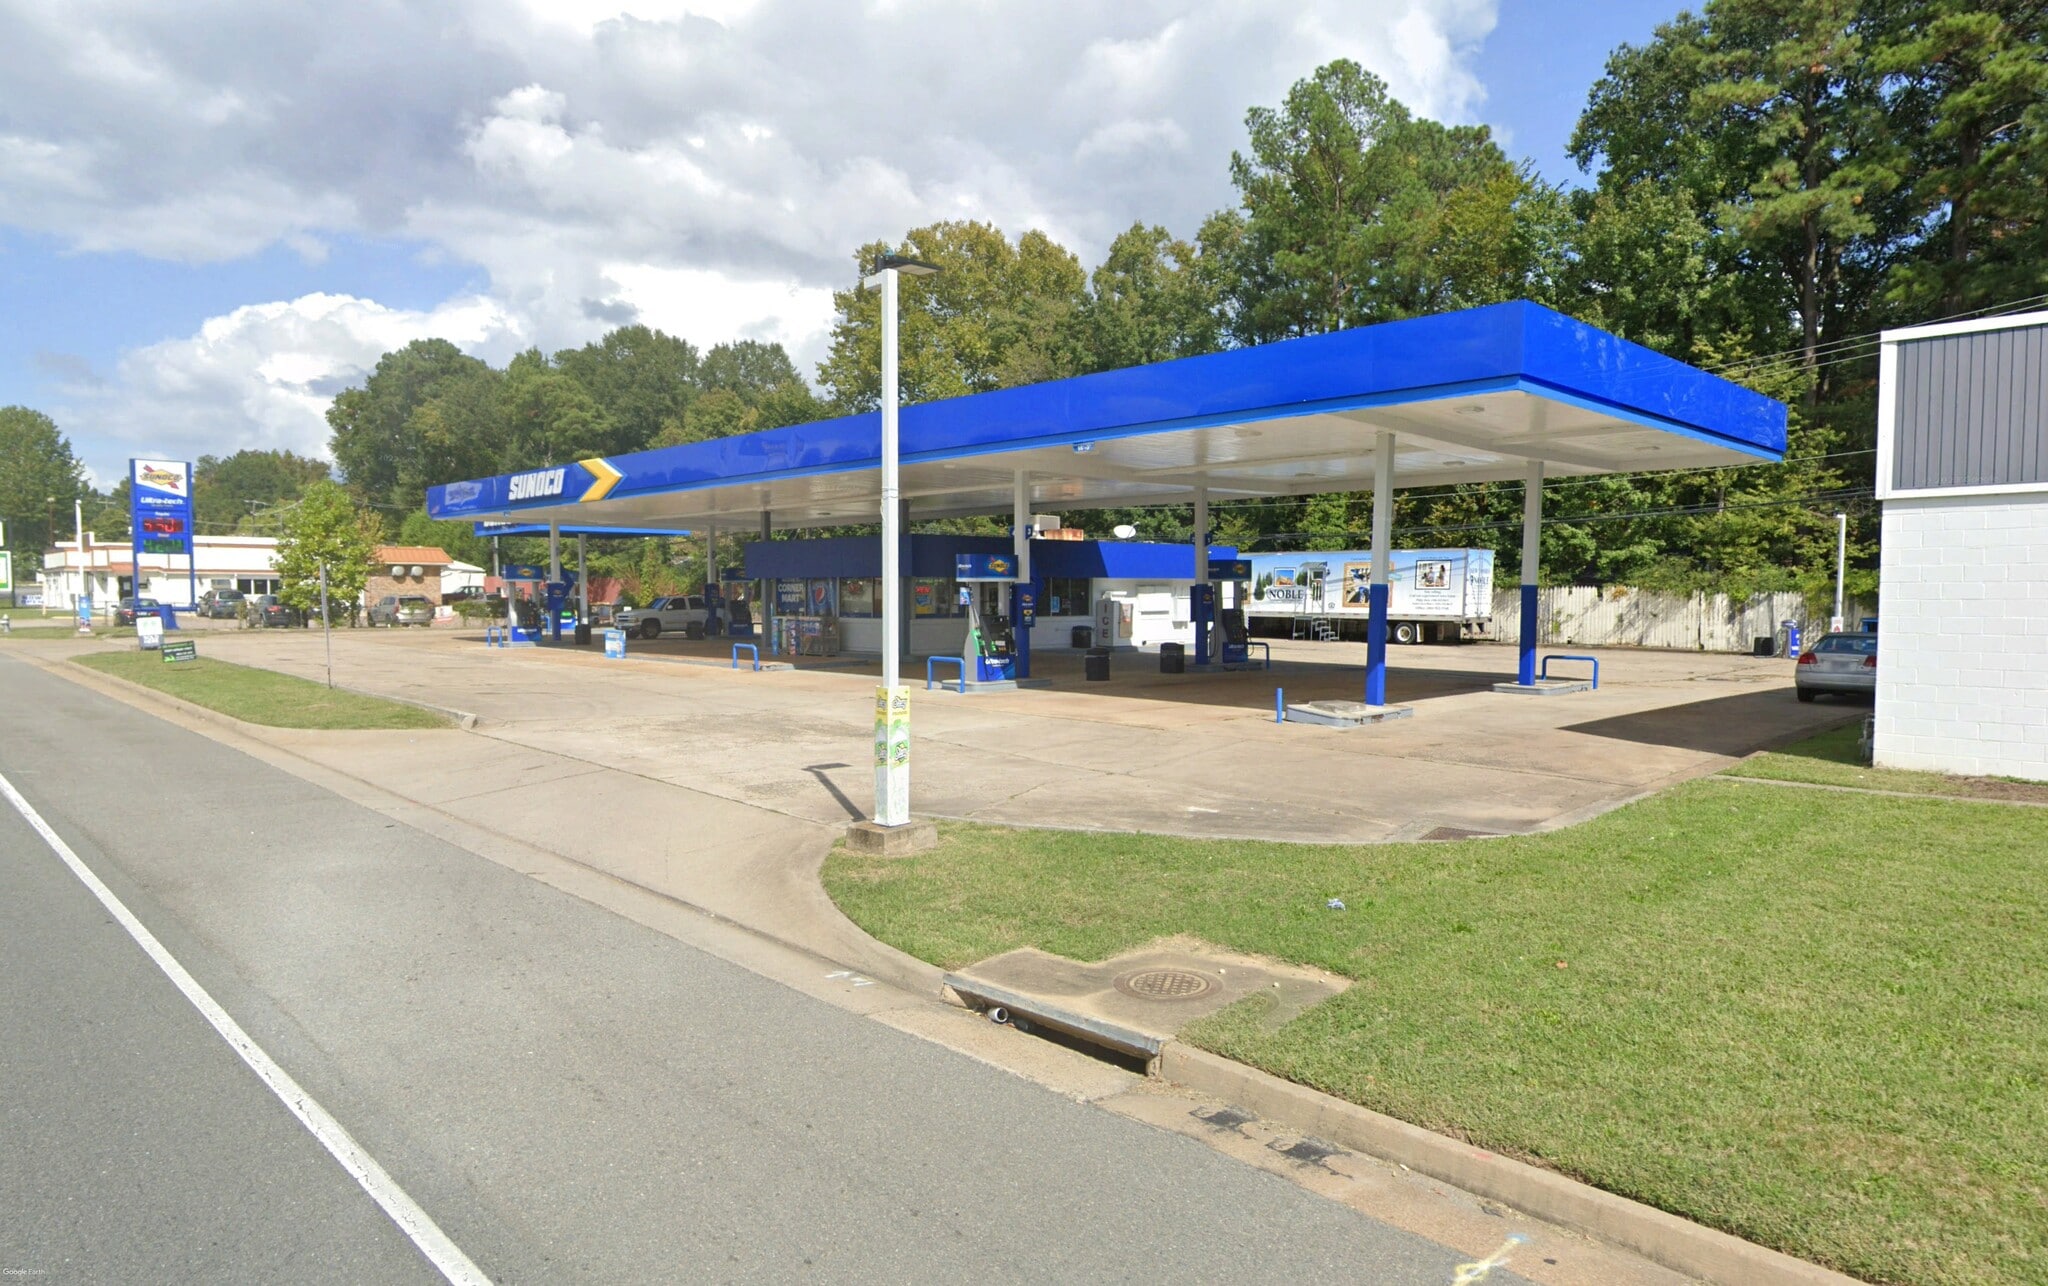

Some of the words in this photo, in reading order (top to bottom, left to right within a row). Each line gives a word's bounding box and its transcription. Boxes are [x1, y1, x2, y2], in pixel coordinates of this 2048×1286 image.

[508, 469, 565, 501] SUNOCO
[778, 583, 804, 593] CORNER
[781, 594, 799, 603] MART
[1269, 589, 1304, 600] NOBLE
